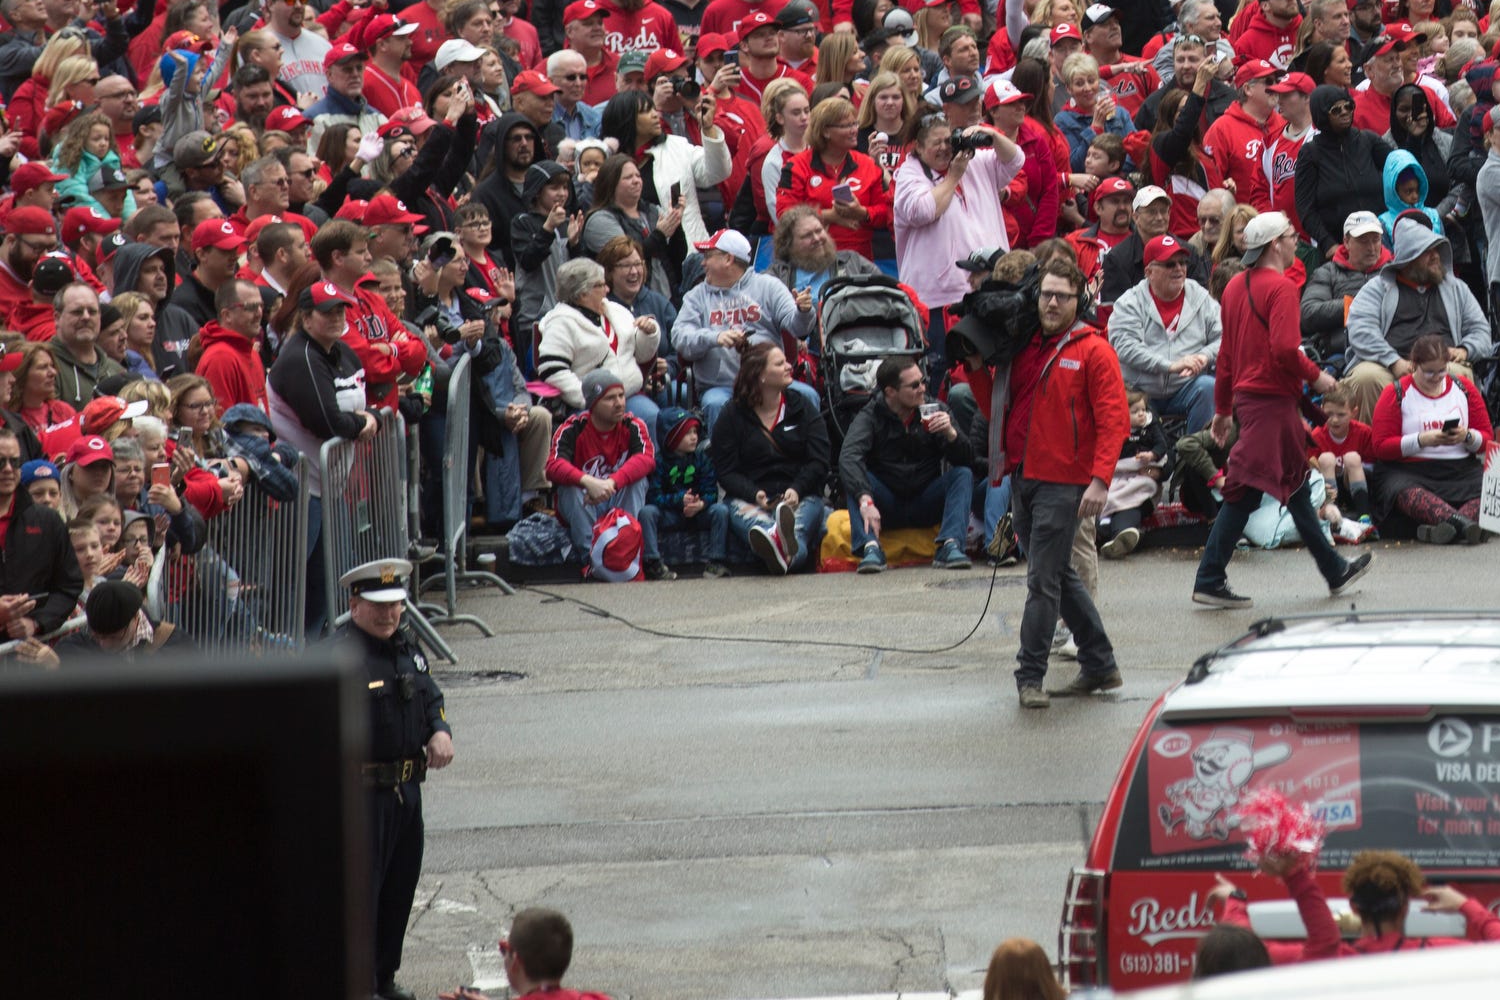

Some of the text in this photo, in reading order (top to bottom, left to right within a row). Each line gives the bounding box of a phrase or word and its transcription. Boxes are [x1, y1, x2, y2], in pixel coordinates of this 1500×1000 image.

[605, 26, 660, 53] Reds
[1437, 762, 1472, 783] VISA
[1415, 791, 1450, 812] Visit
[1453, 795, 1488, 816] your
[1417, 815, 1439, 835] for
[1444, 819, 1484, 835] more
[1128, 891, 1217, 938] Reds
